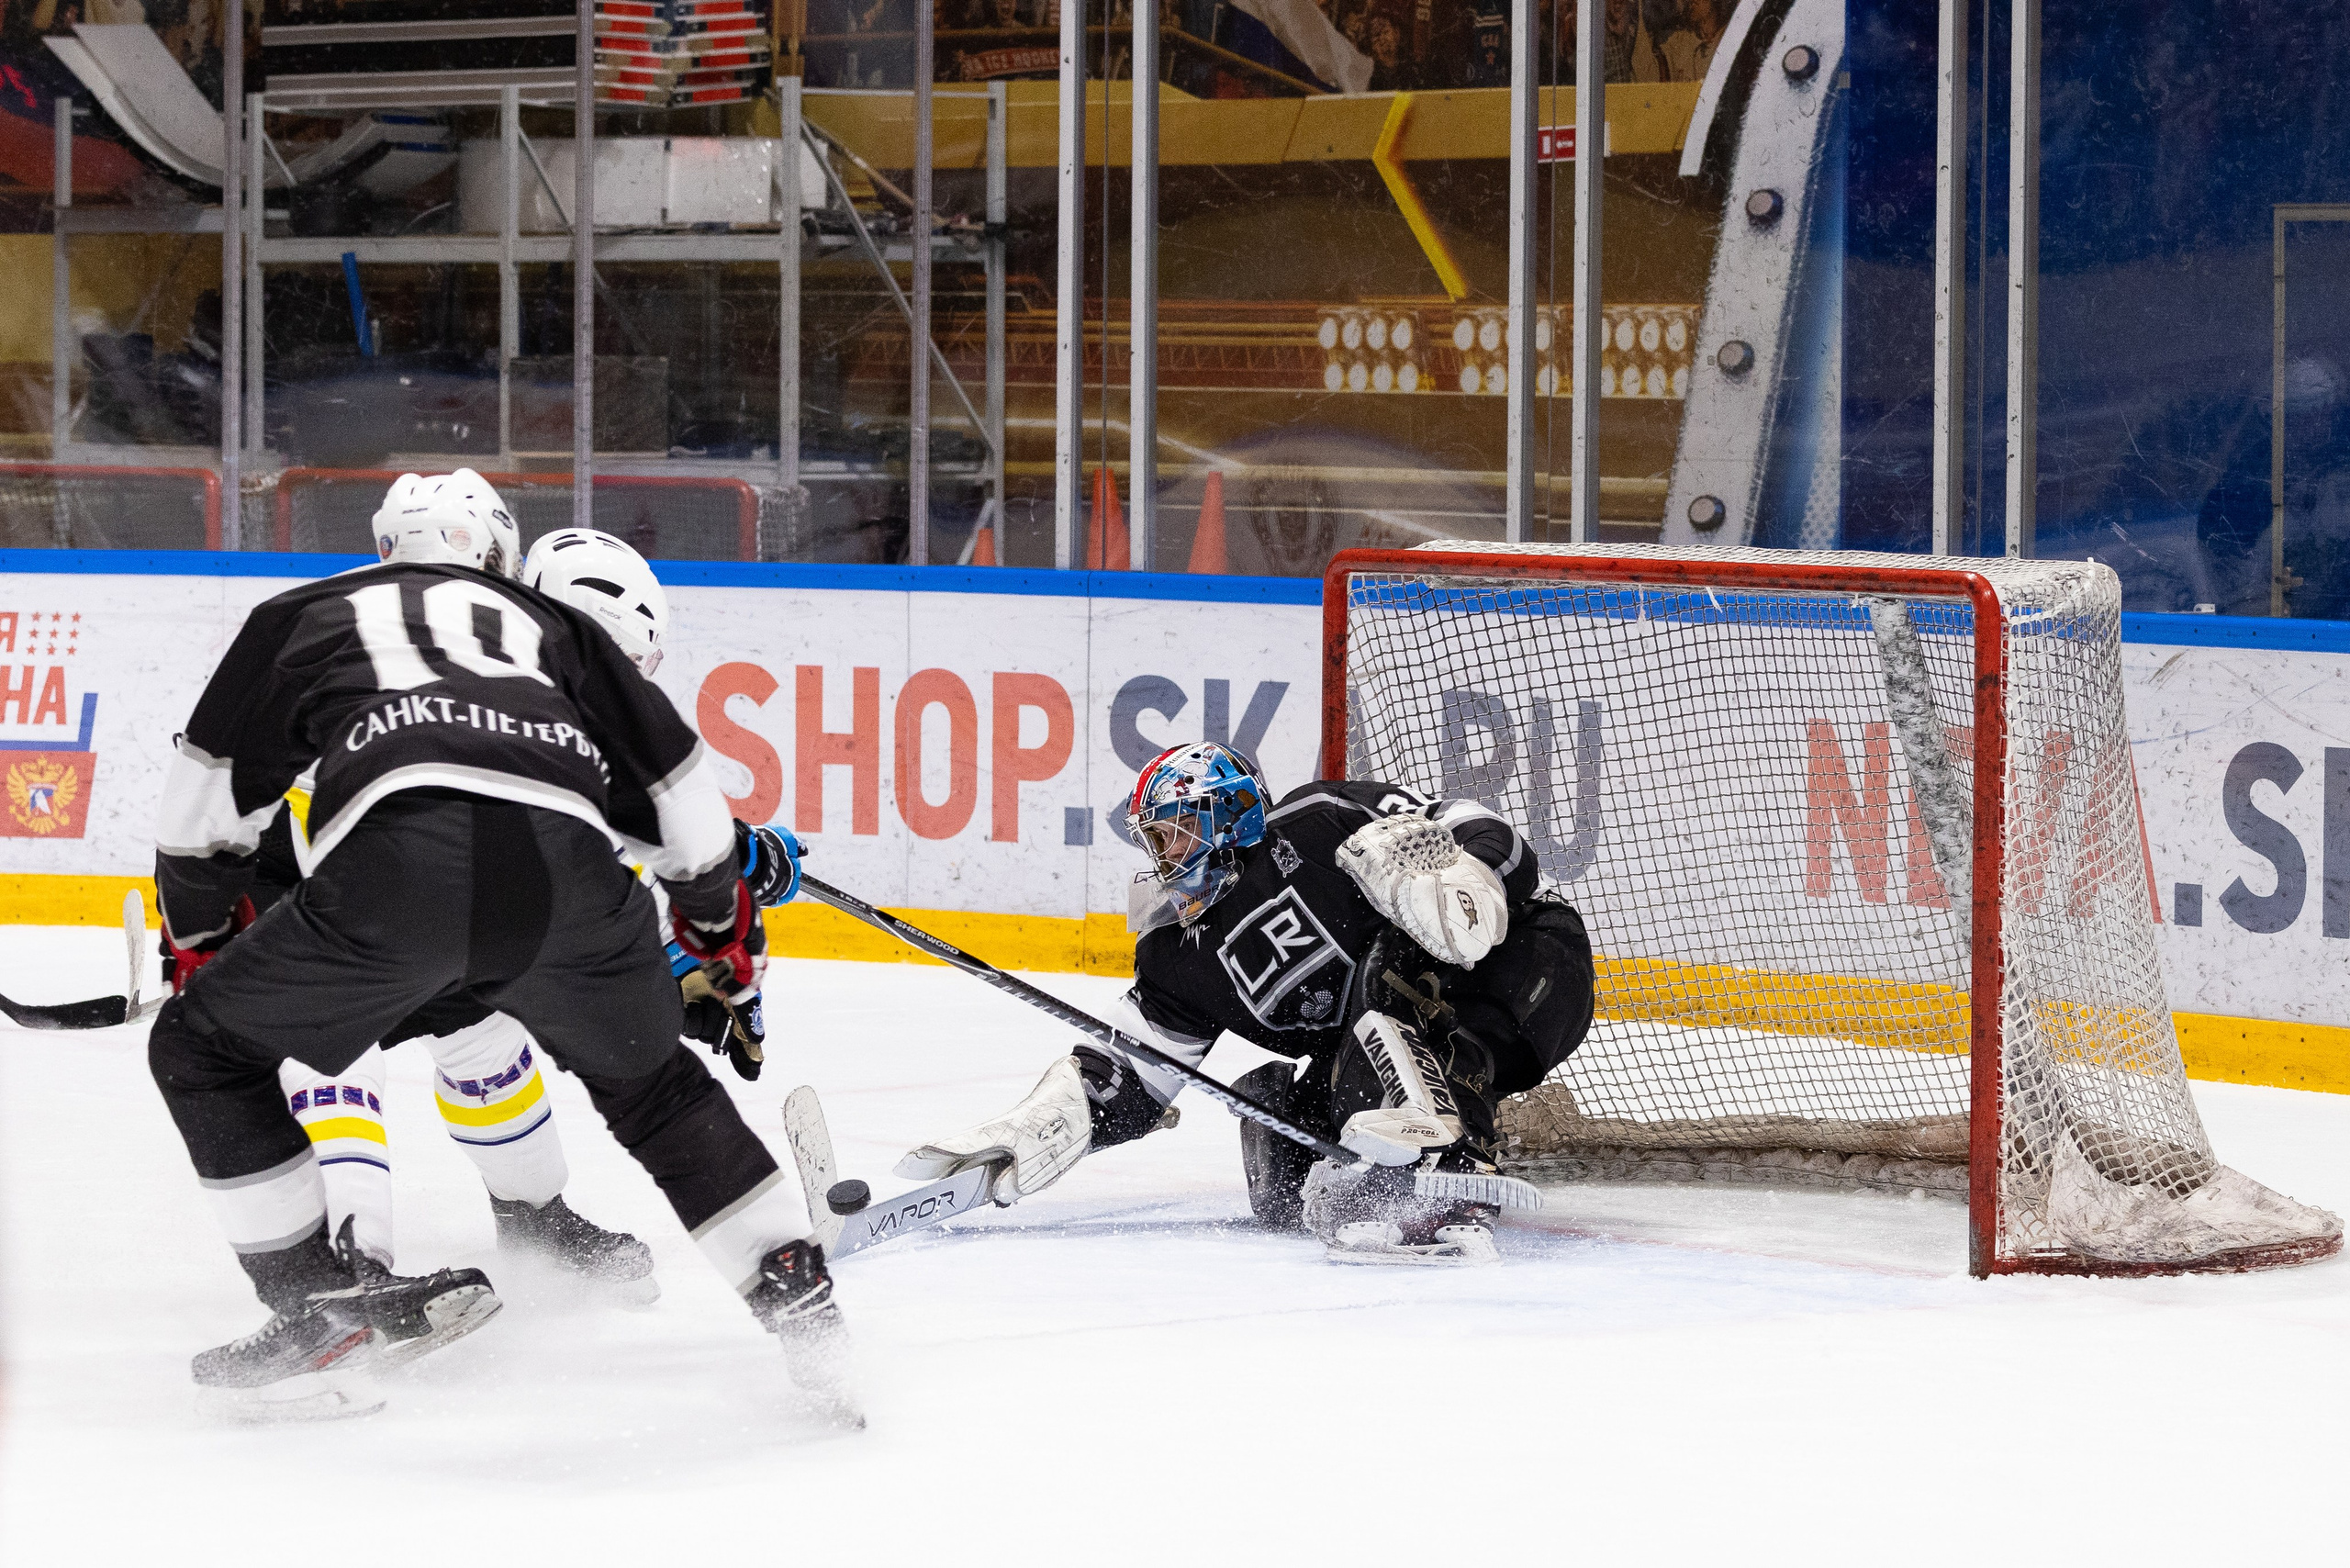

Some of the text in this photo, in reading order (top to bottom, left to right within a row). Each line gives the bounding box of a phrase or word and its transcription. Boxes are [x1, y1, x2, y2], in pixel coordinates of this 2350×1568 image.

[345, 579, 556, 691] 10
[1364, 1026, 1408, 1109] VAUGHN
[864, 1190, 957, 1238] VAPOR
